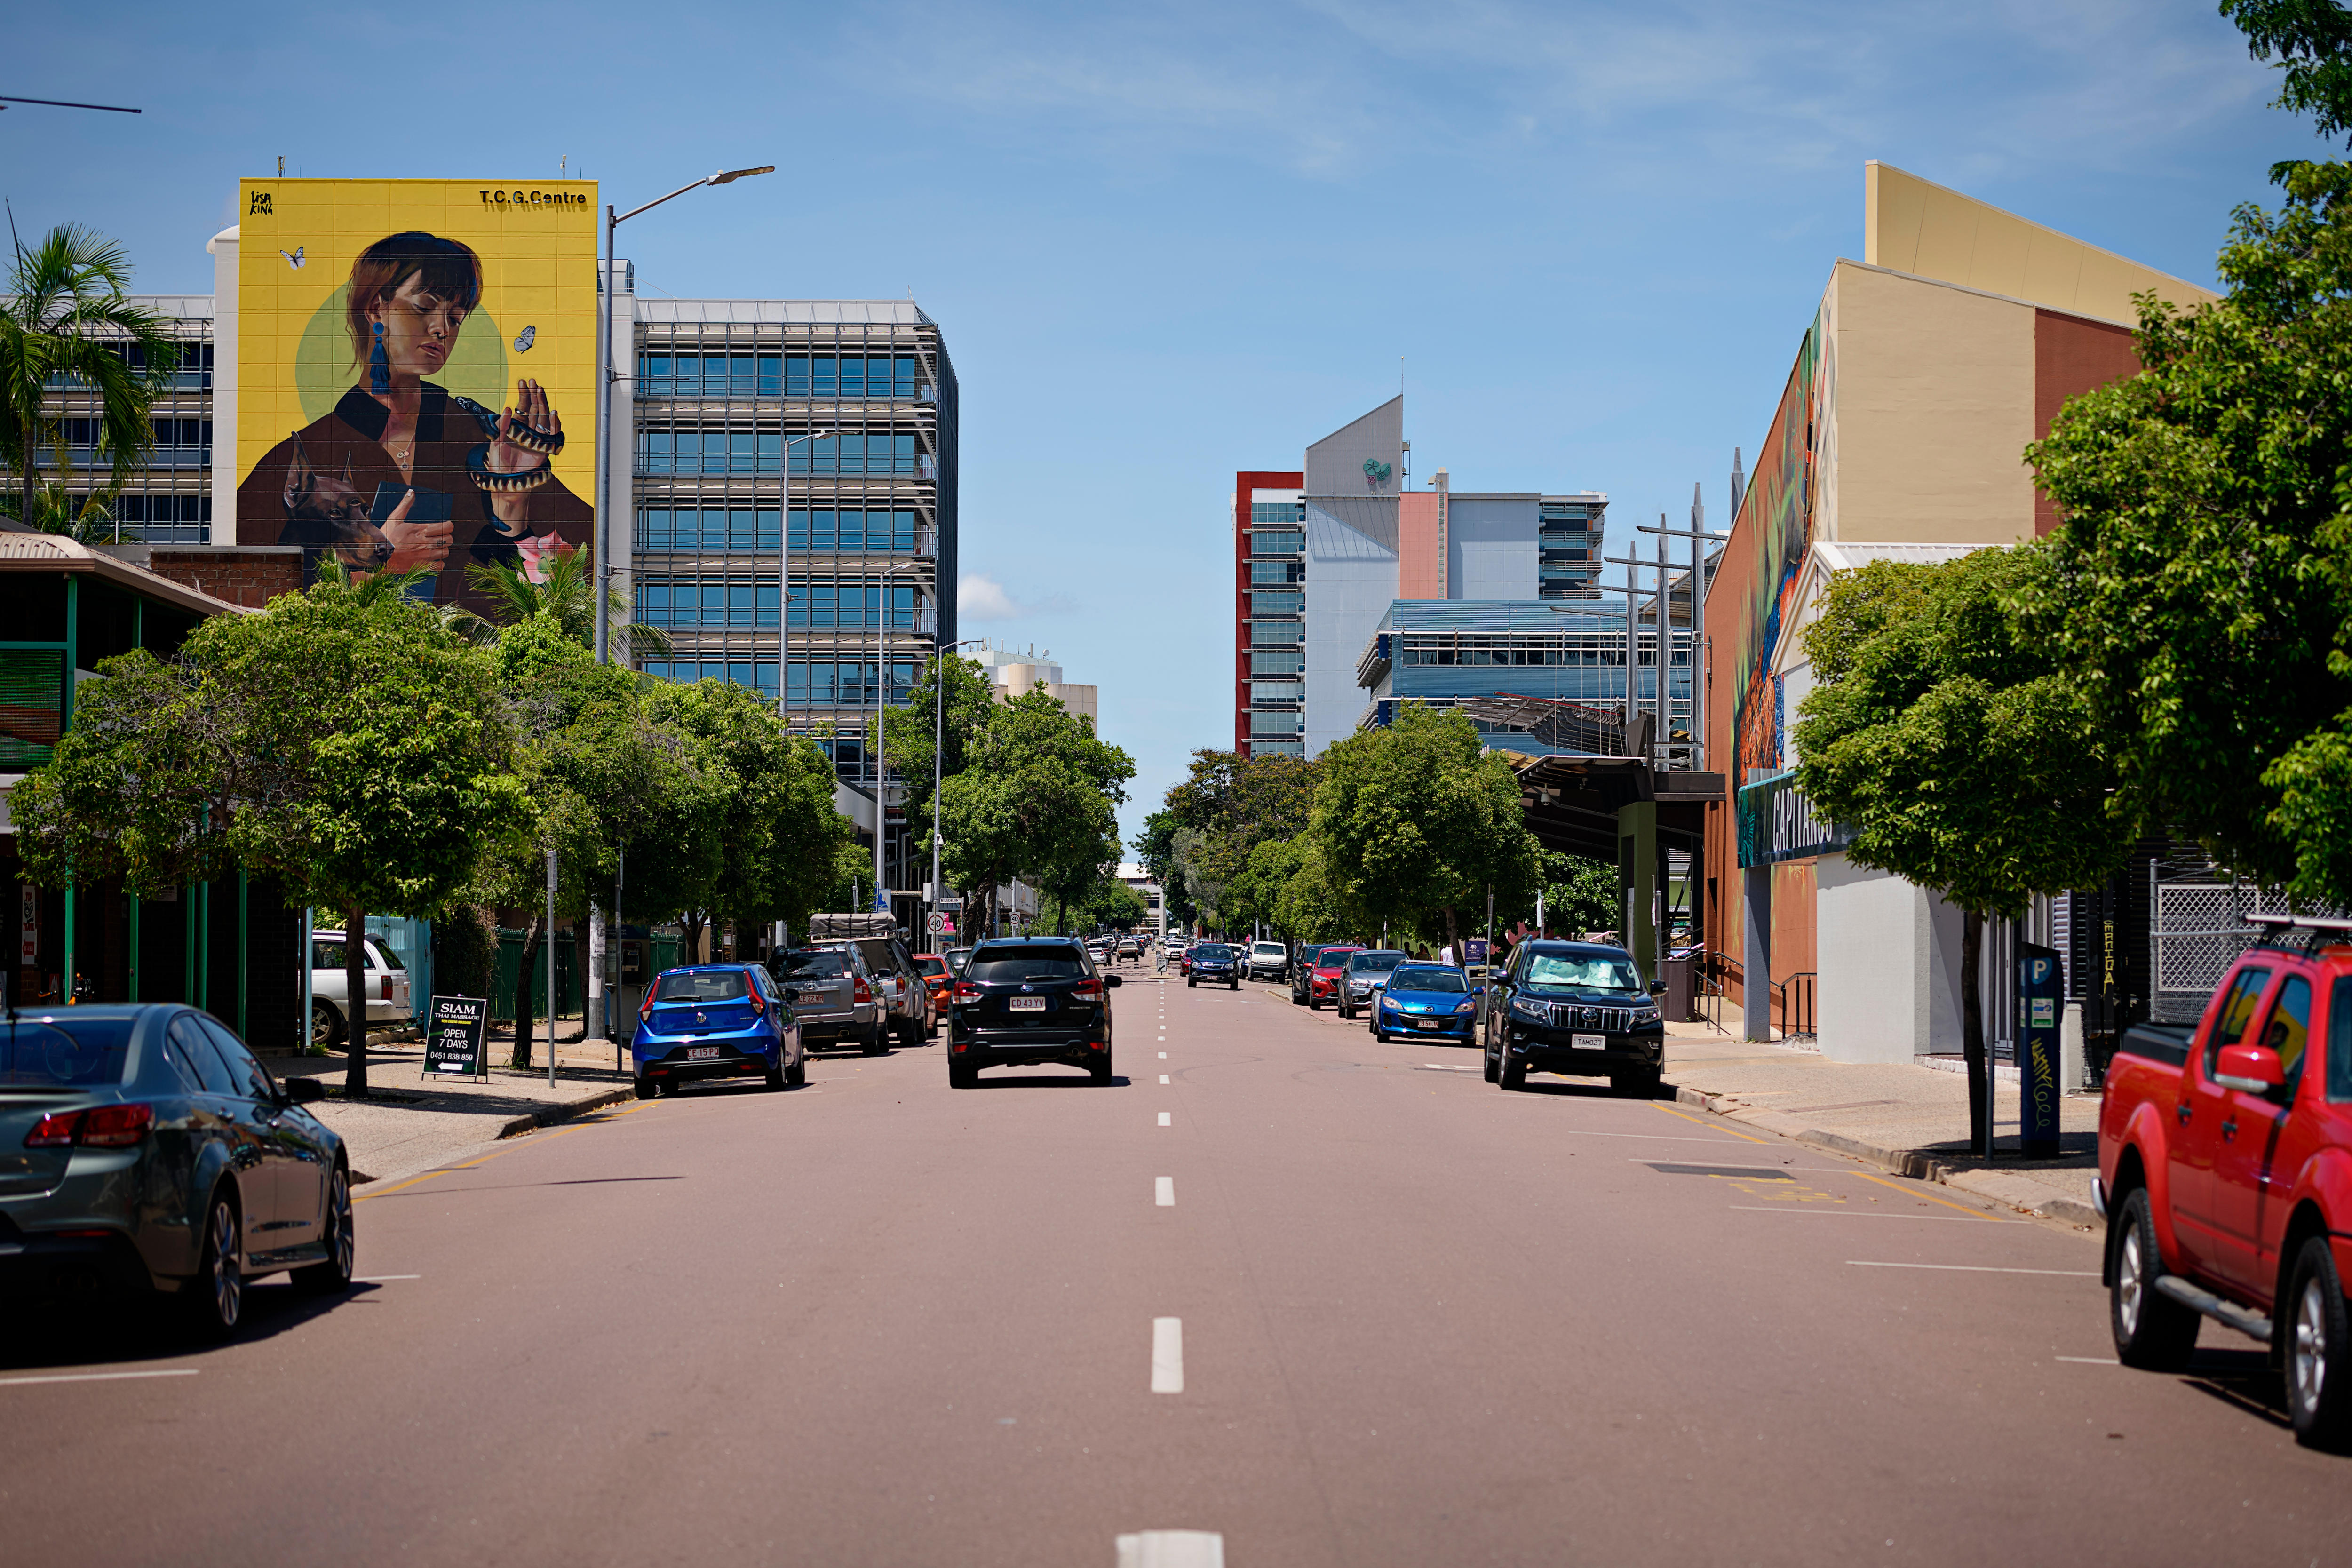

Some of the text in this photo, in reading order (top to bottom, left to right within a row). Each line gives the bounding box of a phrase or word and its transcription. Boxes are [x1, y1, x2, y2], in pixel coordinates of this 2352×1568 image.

[479, 190, 586, 204] T.C.G.Centre
[250, 203, 272, 216] KING
[2034, 960, 2047, 979] P
[440, 1003, 476, 1014] SIAM
[444, 1028, 466, 1038] OPEN
[446, 1039, 468, 1049] DAYS
